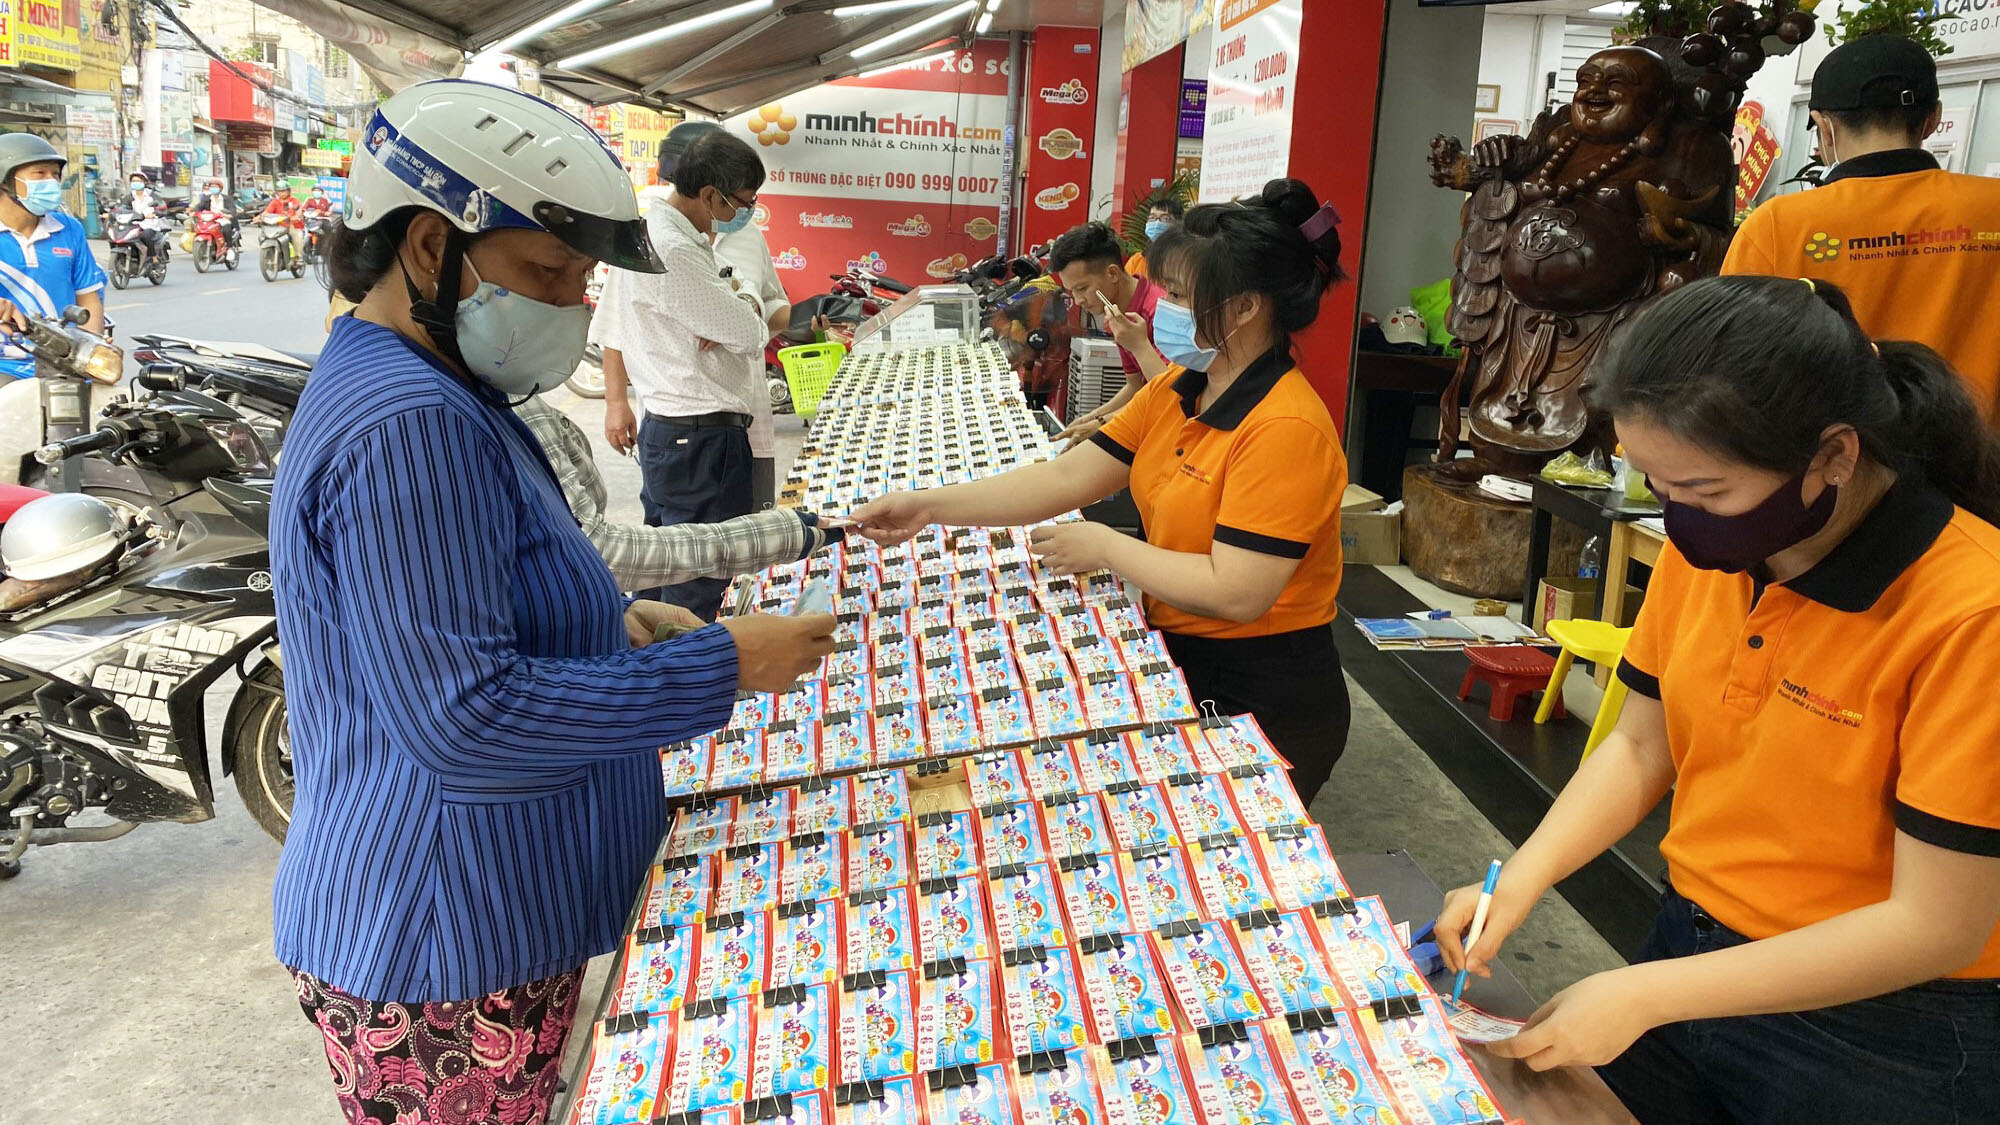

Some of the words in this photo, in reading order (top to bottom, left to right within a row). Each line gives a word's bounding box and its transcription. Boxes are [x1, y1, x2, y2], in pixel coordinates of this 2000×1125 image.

[1042, 88, 1072, 99] Mega
[804, 135, 847, 147] Nhanh
[852, 136, 882, 149] Nhất
[886, 140, 895, 149] &
[900, 140, 938, 152] Chính
[970, 144, 1001, 155] Nhất
[1753, 140, 1770, 165] CHÚC
[770, 167, 785, 182] SỐ
[830, 172, 853, 189] ĐẶC
[857, 173, 881, 190] BIỆT
[885, 171, 916, 189] 090
[921, 174, 952, 191] 999
[957, 176, 999, 194] 0007
[1849, 251, 1884, 261] Nhanh
[1912, 248, 1919, 256] &
